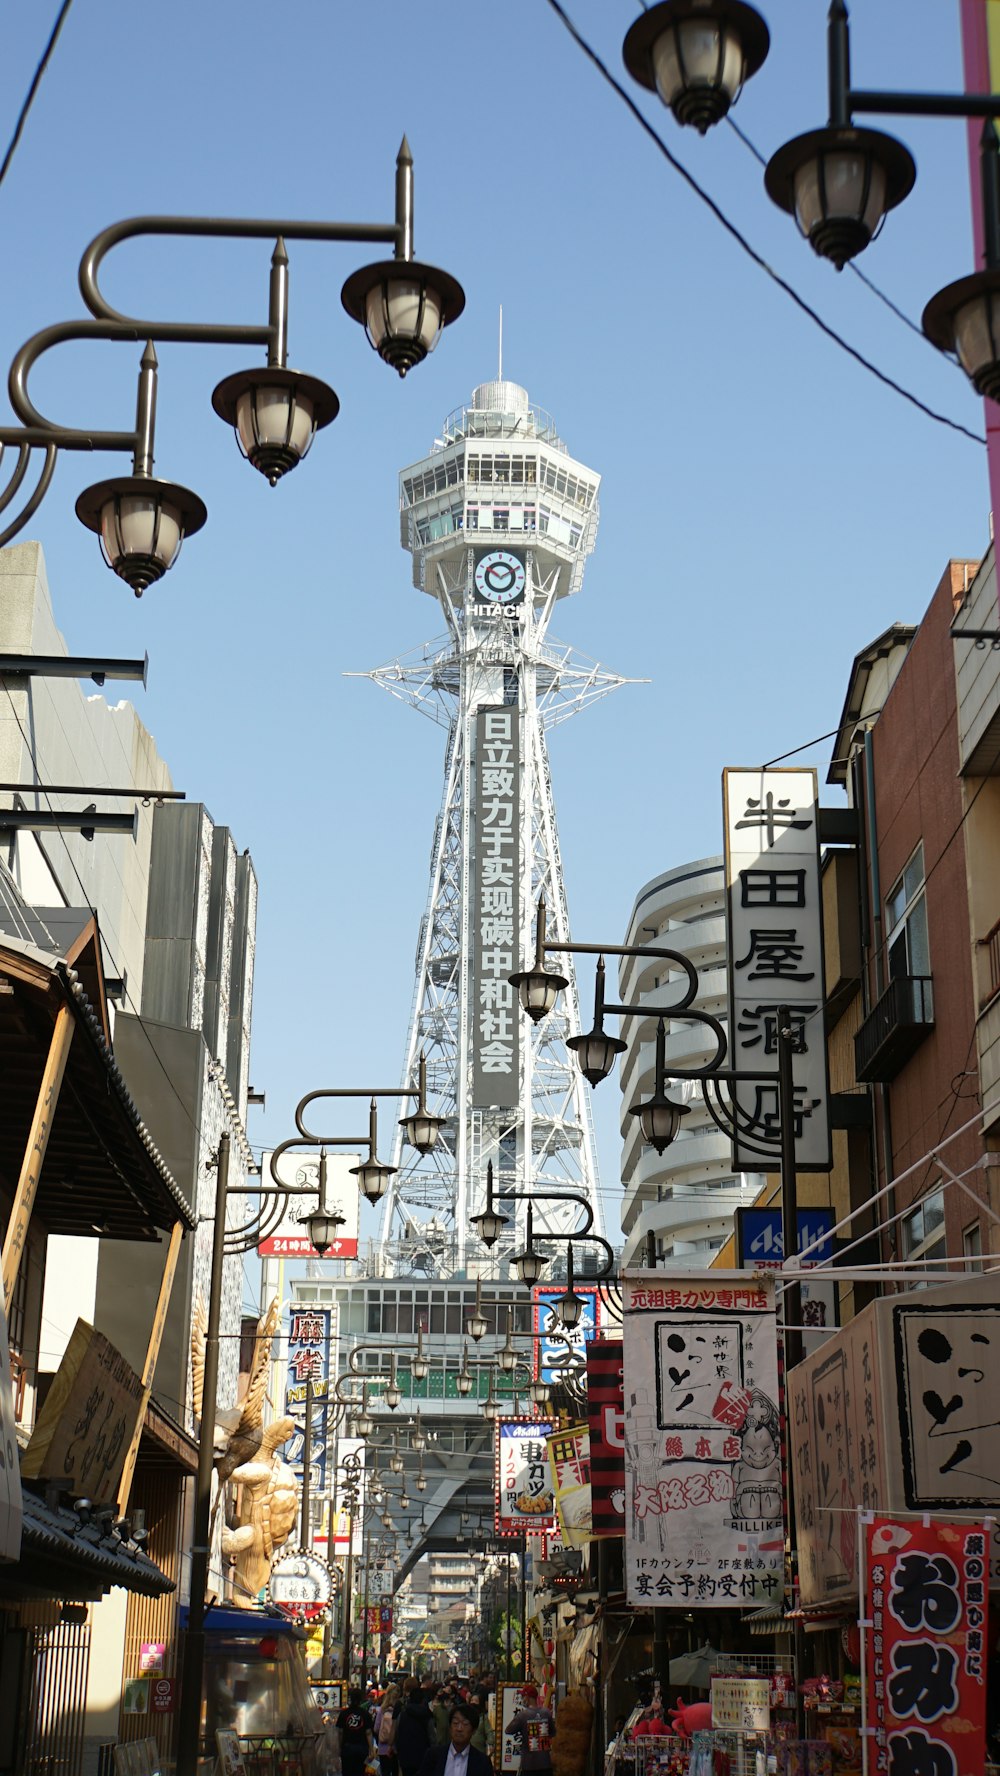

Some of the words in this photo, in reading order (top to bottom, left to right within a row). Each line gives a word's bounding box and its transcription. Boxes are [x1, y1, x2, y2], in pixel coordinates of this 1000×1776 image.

[480, 713, 514, 1074] 日立致力于实现碳中和社会
[735, 791, 820, 1139] 半田屋酒店
[273, 1240, 342, 1252] 24時間中
[750, 1224, 825, 1253] Ashi
[630, 1289, 768, 1308] 元祖串カツ専門店
[290, 1312, 326, 1380] 麻雀
[712, 1335, 734, 1379] 新世界
[513, 1425, 540, 1437] Asahi
[665, 1436, 741, 1457] 総本店
[520, 1440, 545, 1497] 串カツ
[634, 1469, 736, 1518] 大阪名物
[636, 1558, 708, 1569] 1Fカウンター
[718, 1557, 778, 1570] 2F座敷あり
[635, 1573, 780, 1597] 宴会予約受付中
